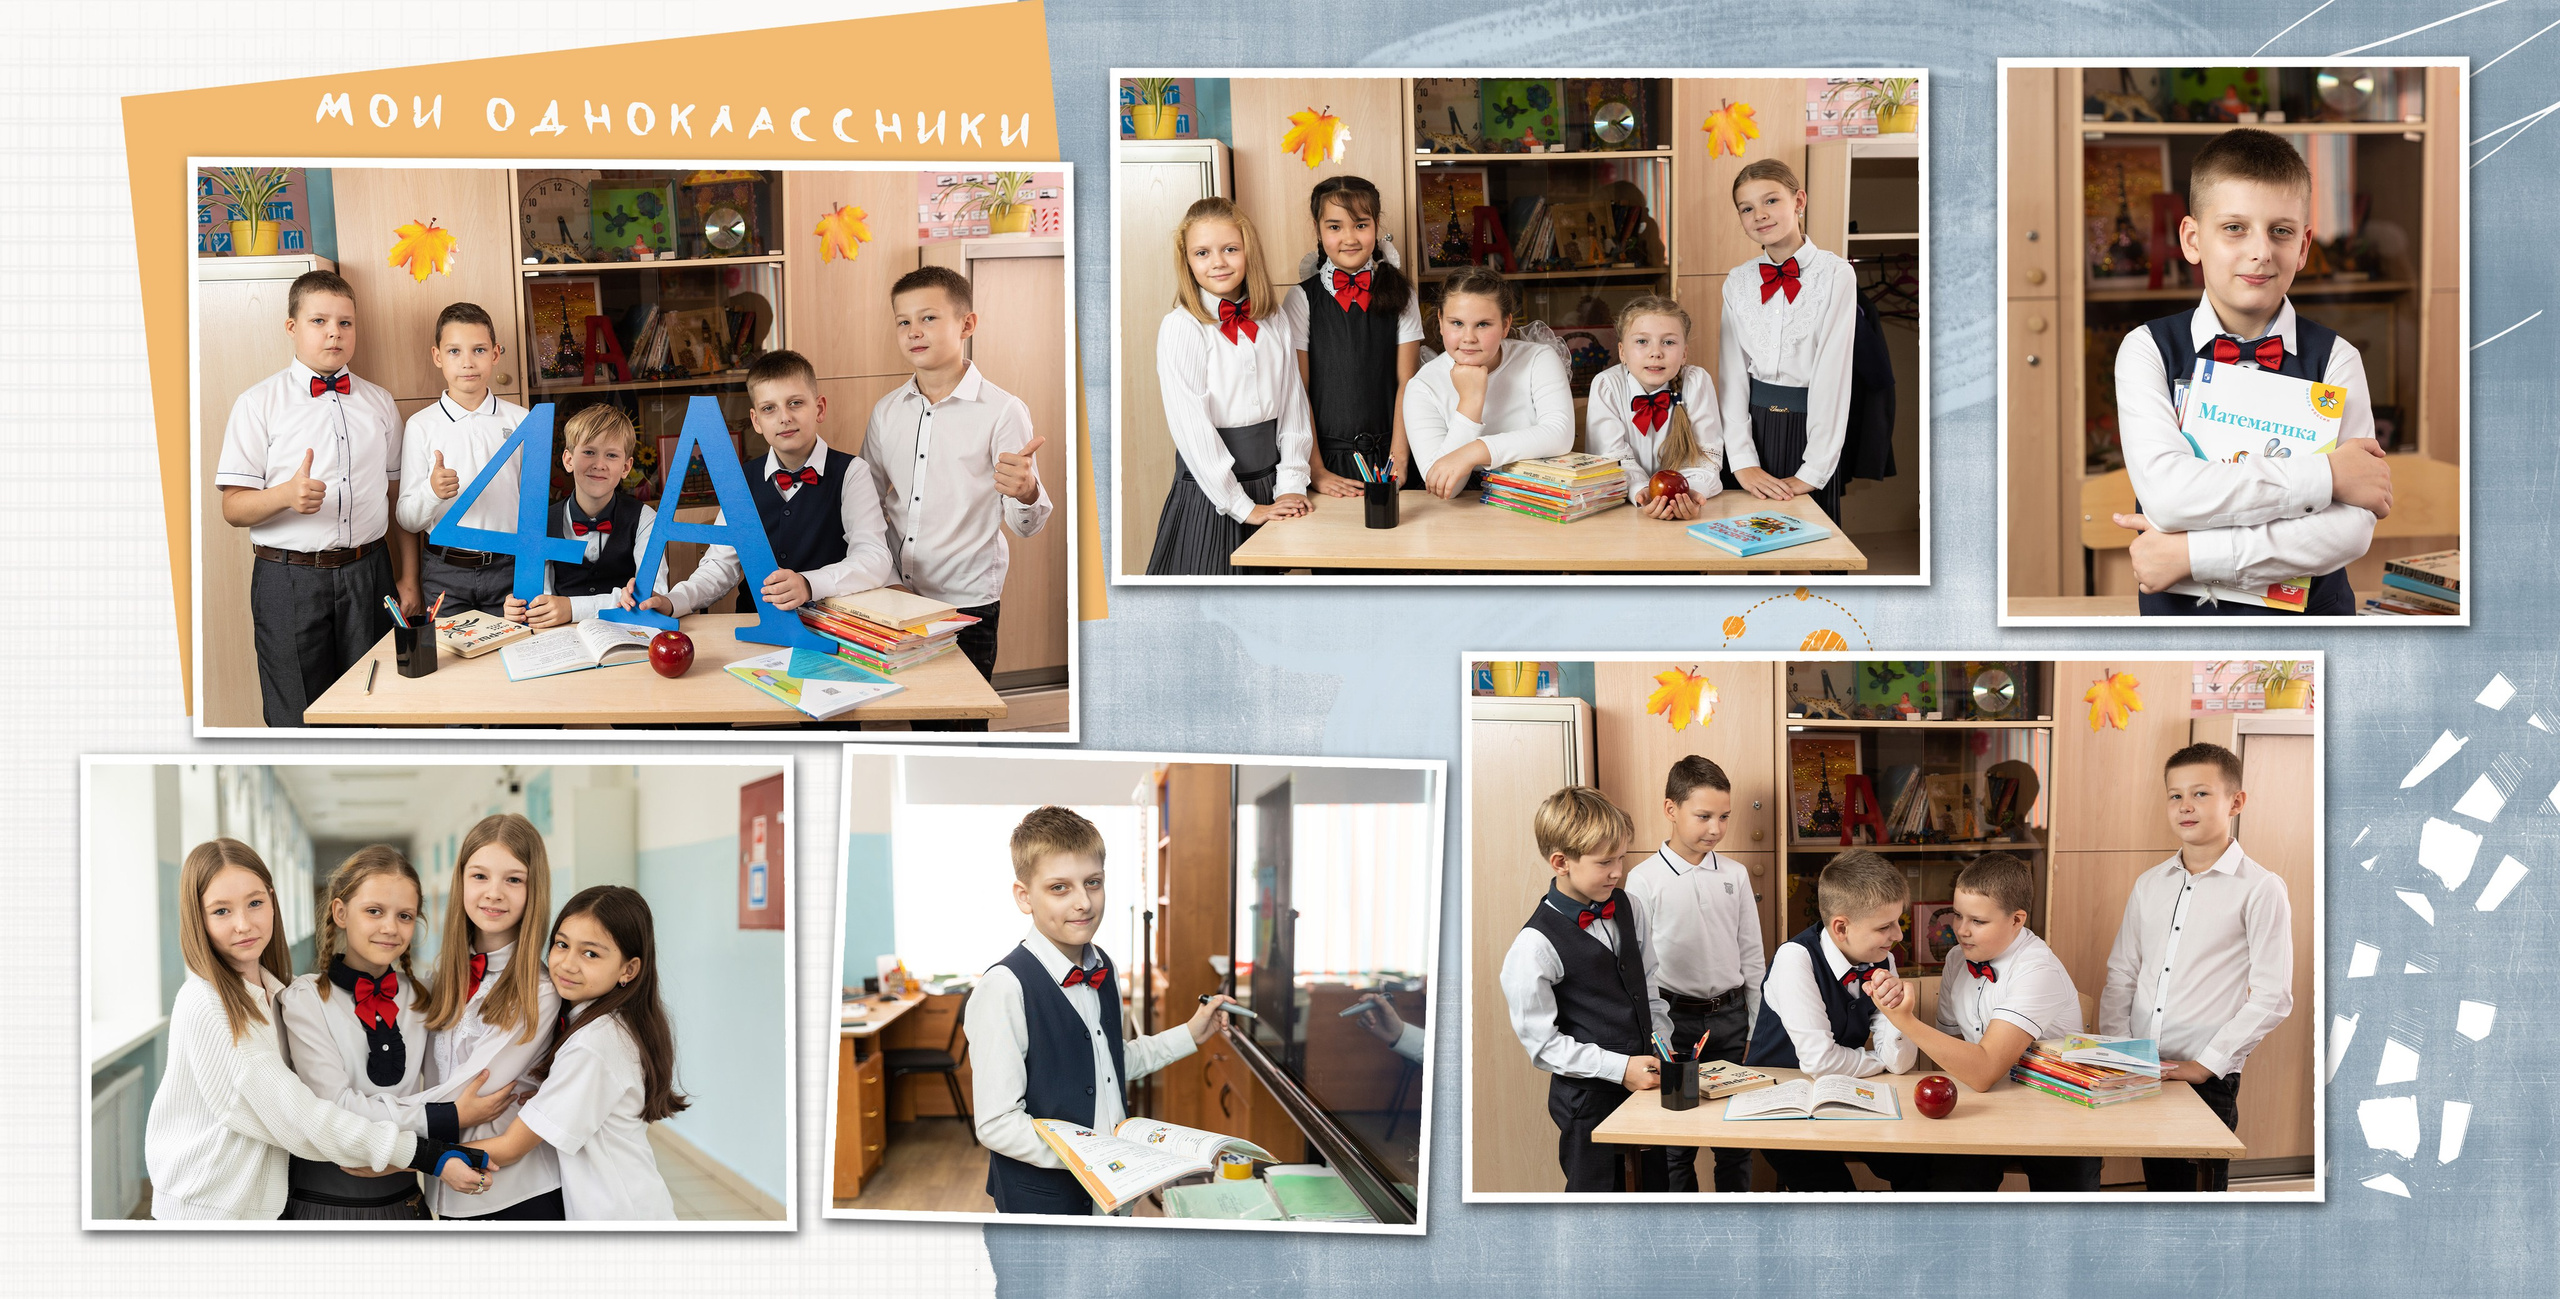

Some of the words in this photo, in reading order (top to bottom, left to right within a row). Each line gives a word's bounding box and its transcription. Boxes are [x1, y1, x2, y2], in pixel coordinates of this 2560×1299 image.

[1420, 88, 1428, 97] 10
[1473, 90, 1480, 99] 2
[1417, 104, 1422, 113] 9
[1421, 120, 1426, 129] 8
[1472, 122, 1478, 131] 4
[540, 187, 546, 196] 11
[553, 183, 562, 192] 12
[571, 187, 575, 196] 1
[528, 198, 537, 207] 10
[583, 199, 590, 208] 2
[526, 214, 531, 224] 9
[530, 230, 536, 239] 8
[583, 231, 589, 240] 4
[2197, 401, 2317, 442] Математика
[1788, 666, 1794, 676] 9
[1793, 683, 1798, 692] 8
[1846, 687, 1852, 696] 4
